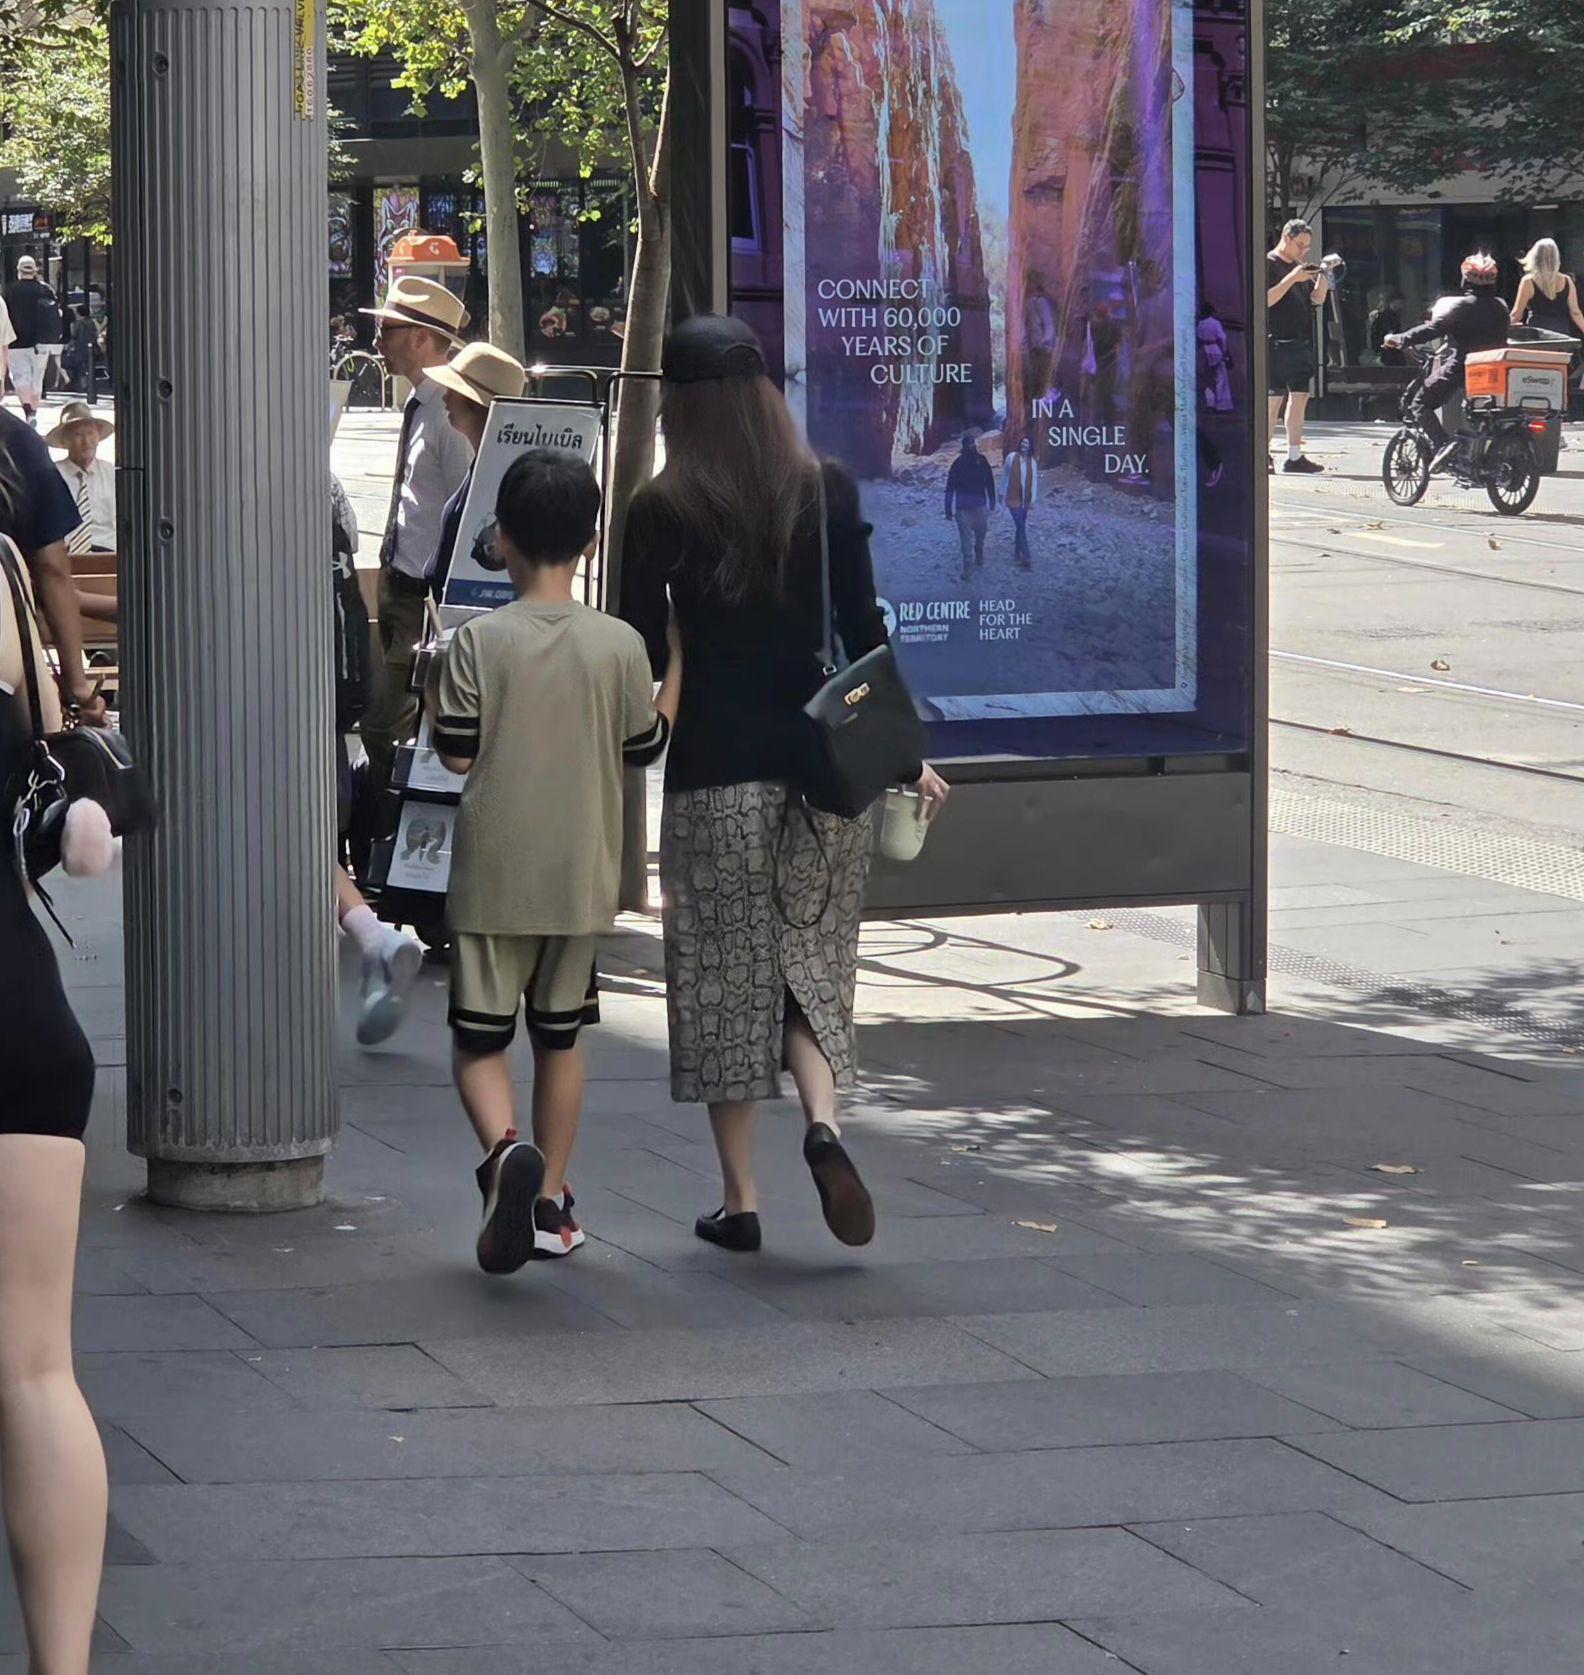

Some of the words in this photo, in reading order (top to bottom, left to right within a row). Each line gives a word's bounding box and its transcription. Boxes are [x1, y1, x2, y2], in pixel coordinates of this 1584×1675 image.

[817, 279, 931, 300] CONNECT
[818, 308, 877, 328] WITH
[883, 307, 961, 331] 60,000
[841, 336, 911, 356] YEARS
[917, 335, 949, 355] OF
[870, 363, 973, 384] CULTURE
[1031, 398, 1053, 418] IN
[1058, 398, 1074, 418] A
[496, 423, 583, 449] เรียนไบเบิล
[1048, 426, 1126, 446] SINGLE
[1104, 454, 1149, 474] DAY.
[900, 602, 924, 622] RED
[926, 601, 971, 620] CENTRE
[979, 599, 1015, 612] HEAD
[900, 624, 949, 634] NORTHERN
[979, 614, 1006, 626] FOR
[1008, 613, 1032, 625] THE
[900, 633, 949, 643] TERRITORY
[979, 627, 1021, 640] HEART
